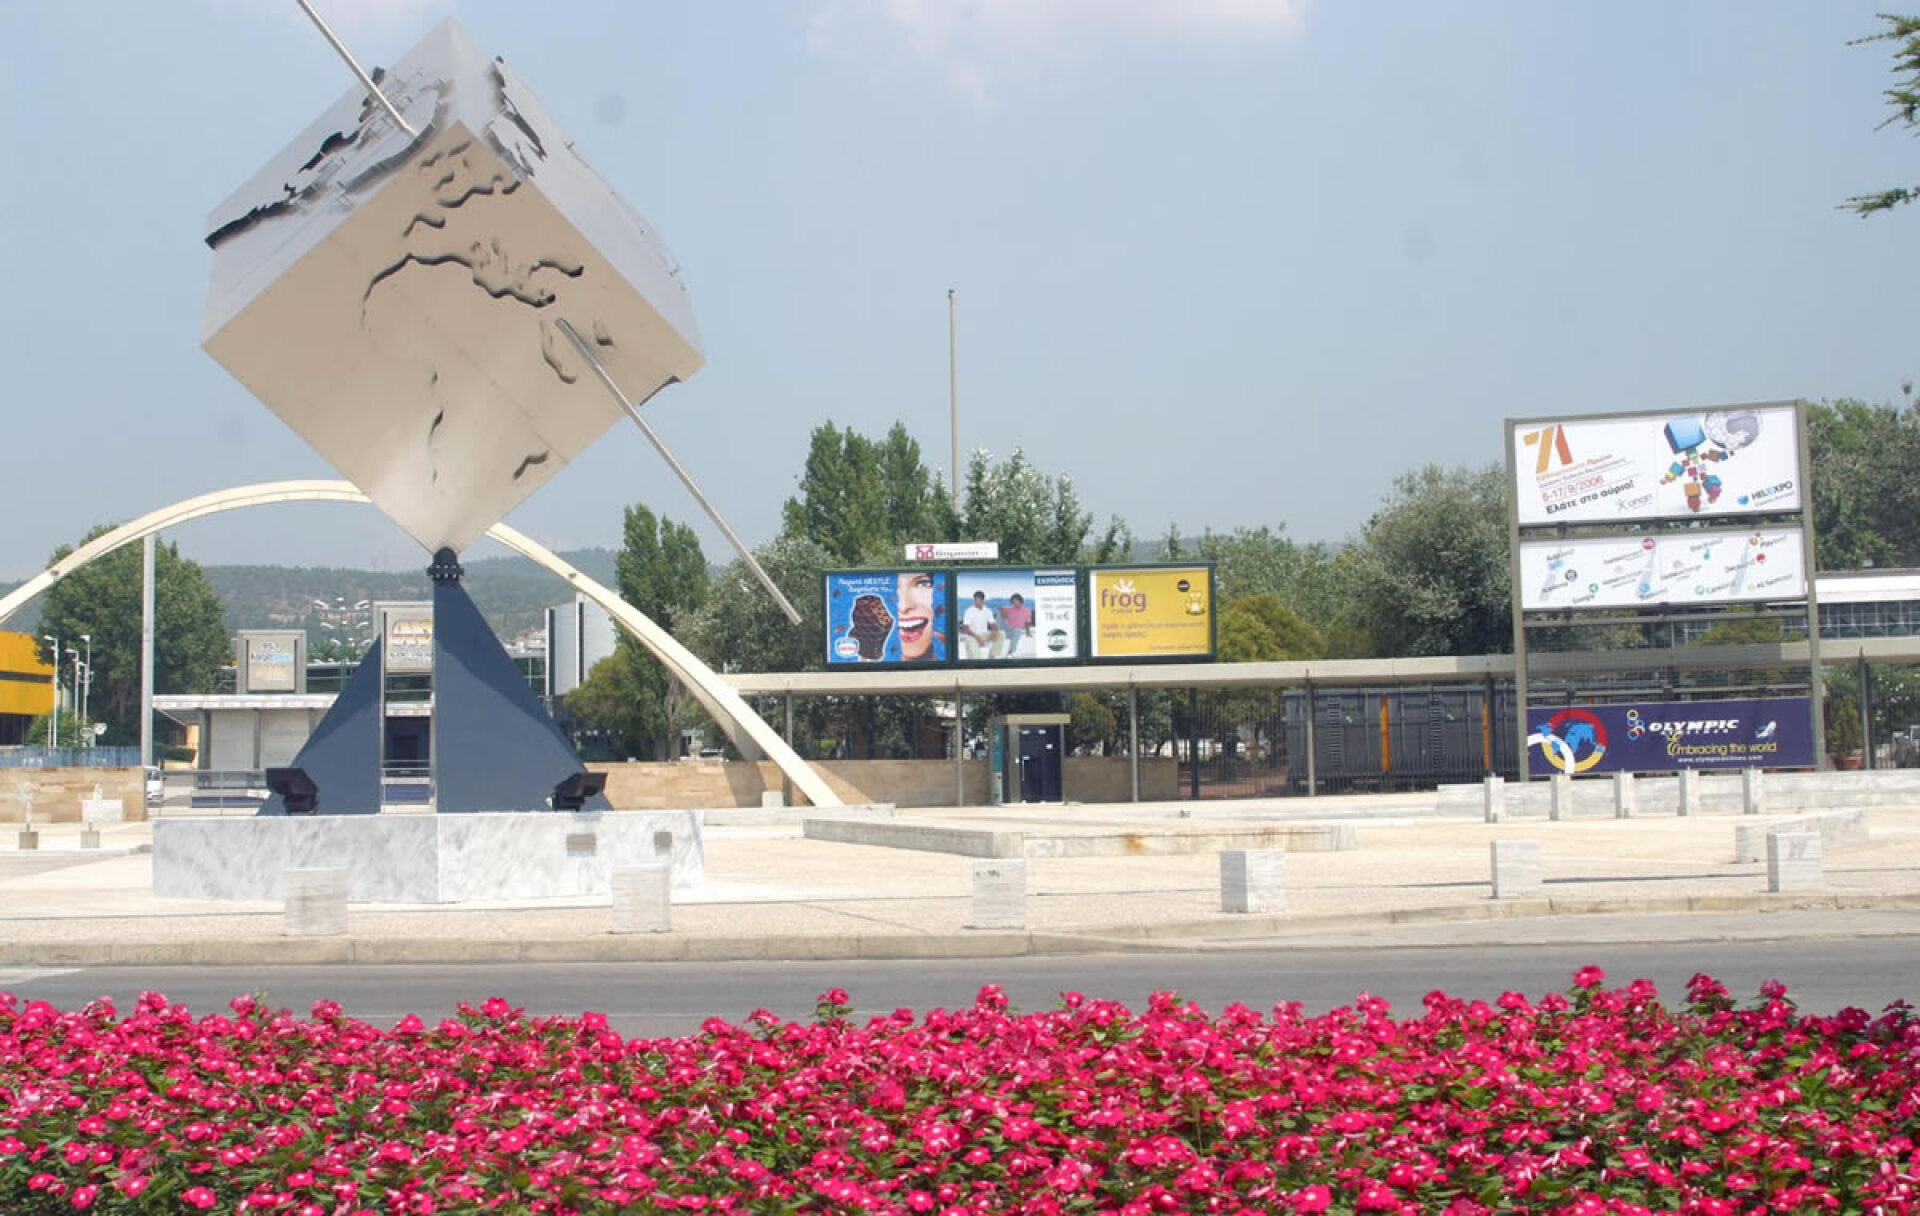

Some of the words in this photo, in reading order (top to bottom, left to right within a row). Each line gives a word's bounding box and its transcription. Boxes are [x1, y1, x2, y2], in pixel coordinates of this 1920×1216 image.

[1101, 588, 1147, 613] frog
[1649, 719, 1740, 732] OLYMPIC
[1729, 743, 1746, 754] the
[1750, 742, 1777, 754] world
